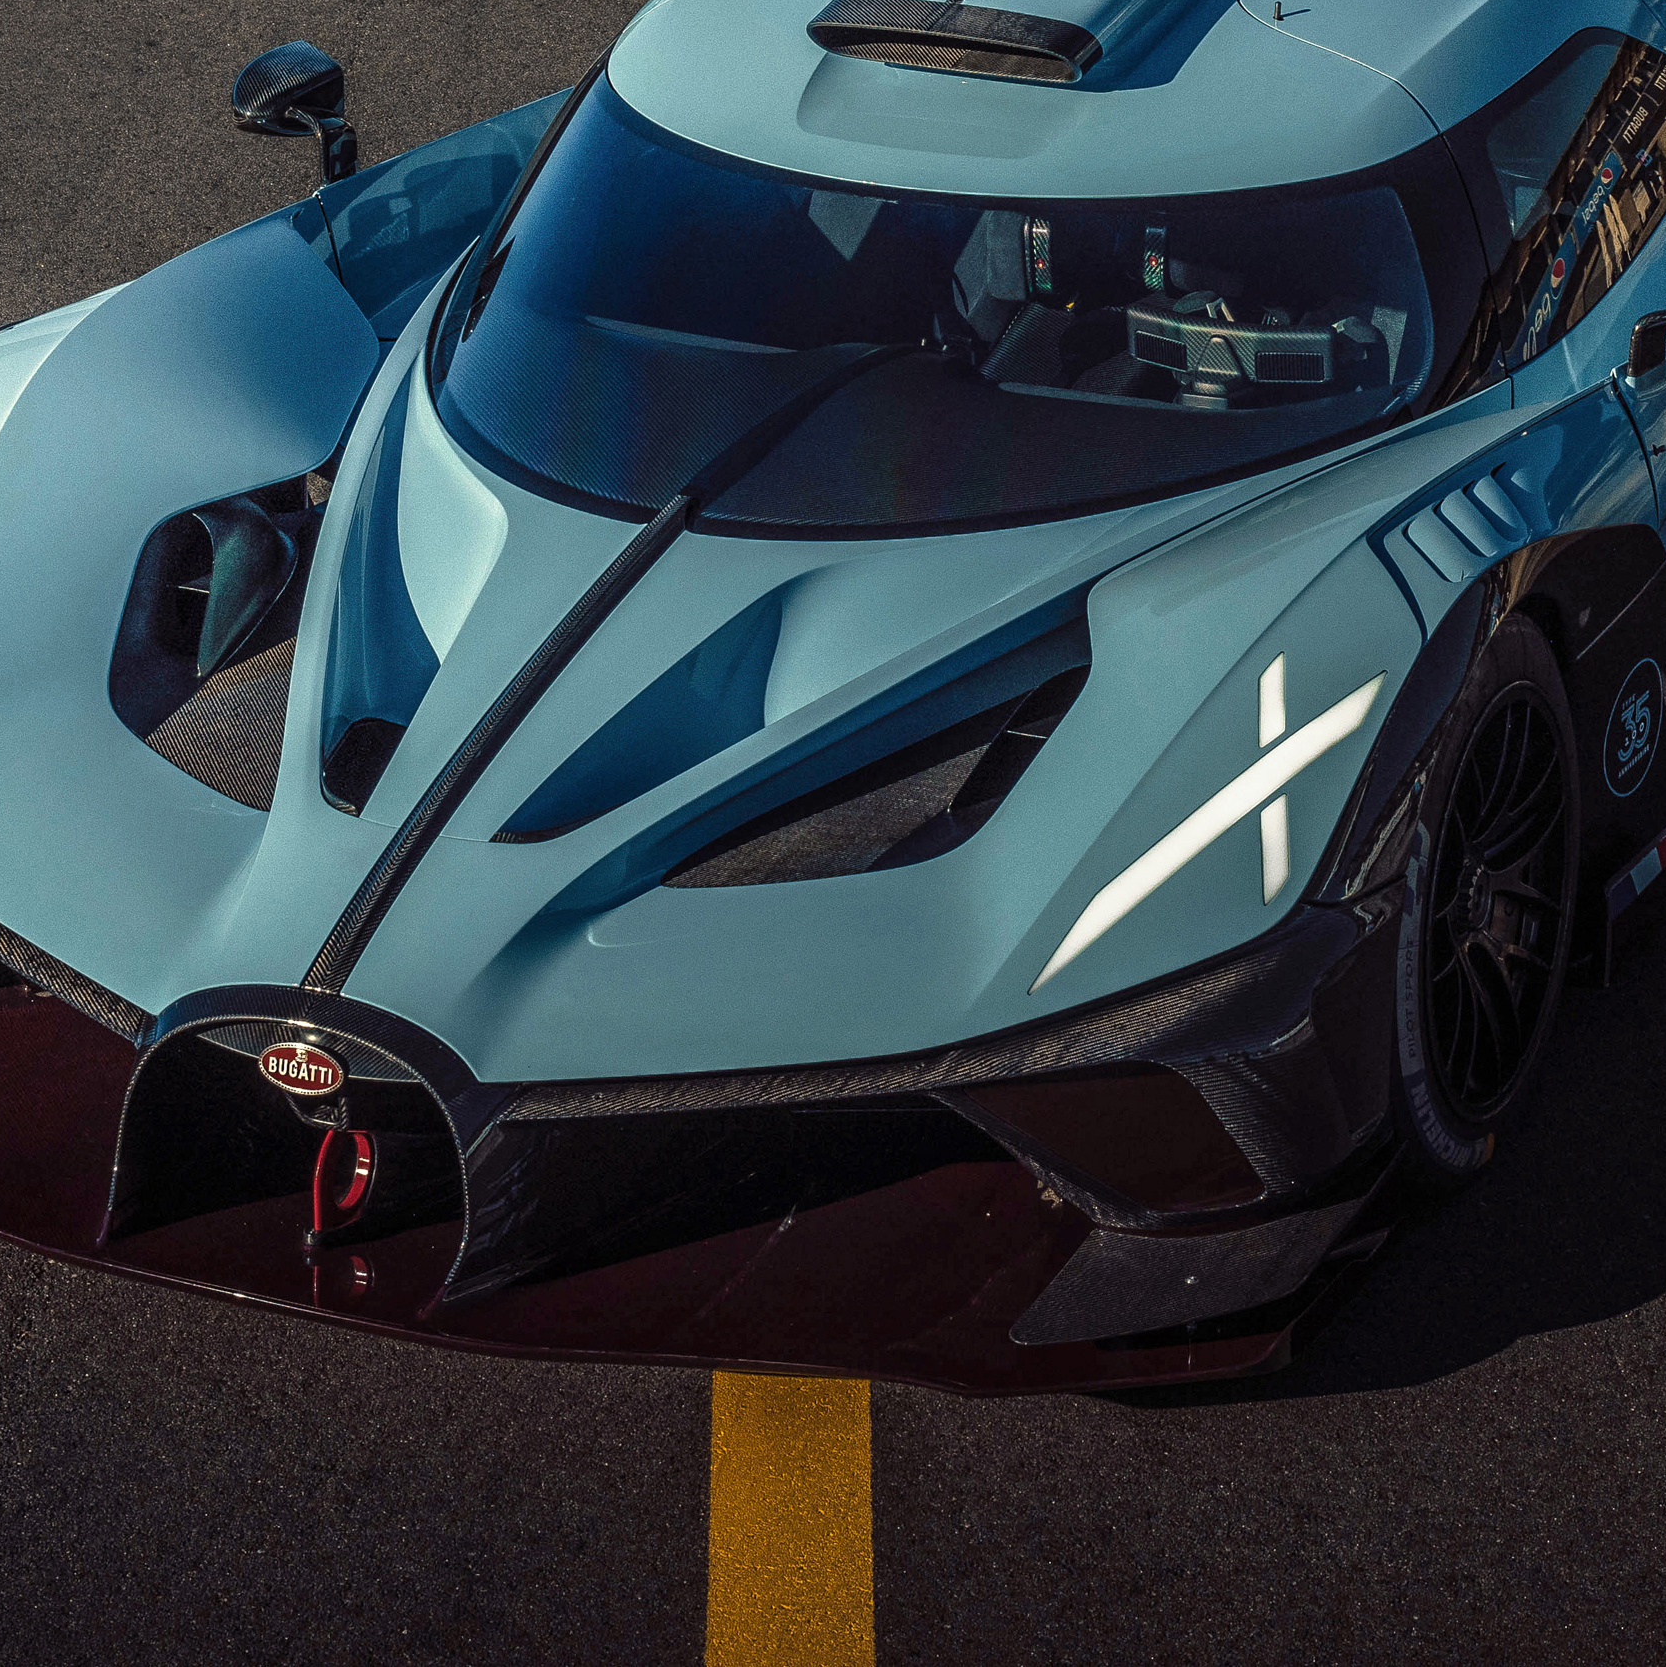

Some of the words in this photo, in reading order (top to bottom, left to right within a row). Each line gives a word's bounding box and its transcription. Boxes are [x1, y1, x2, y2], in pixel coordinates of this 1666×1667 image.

[1617, 689, 1651, 762] 35
[1405, 936, 1414, 1001] SPORT
[1405, 1008, 1416, 1059] PILOT
[268, 1056, 333, 1085] BUGATTI
[1410, 1082, 1473, 1169] MICHELIN
